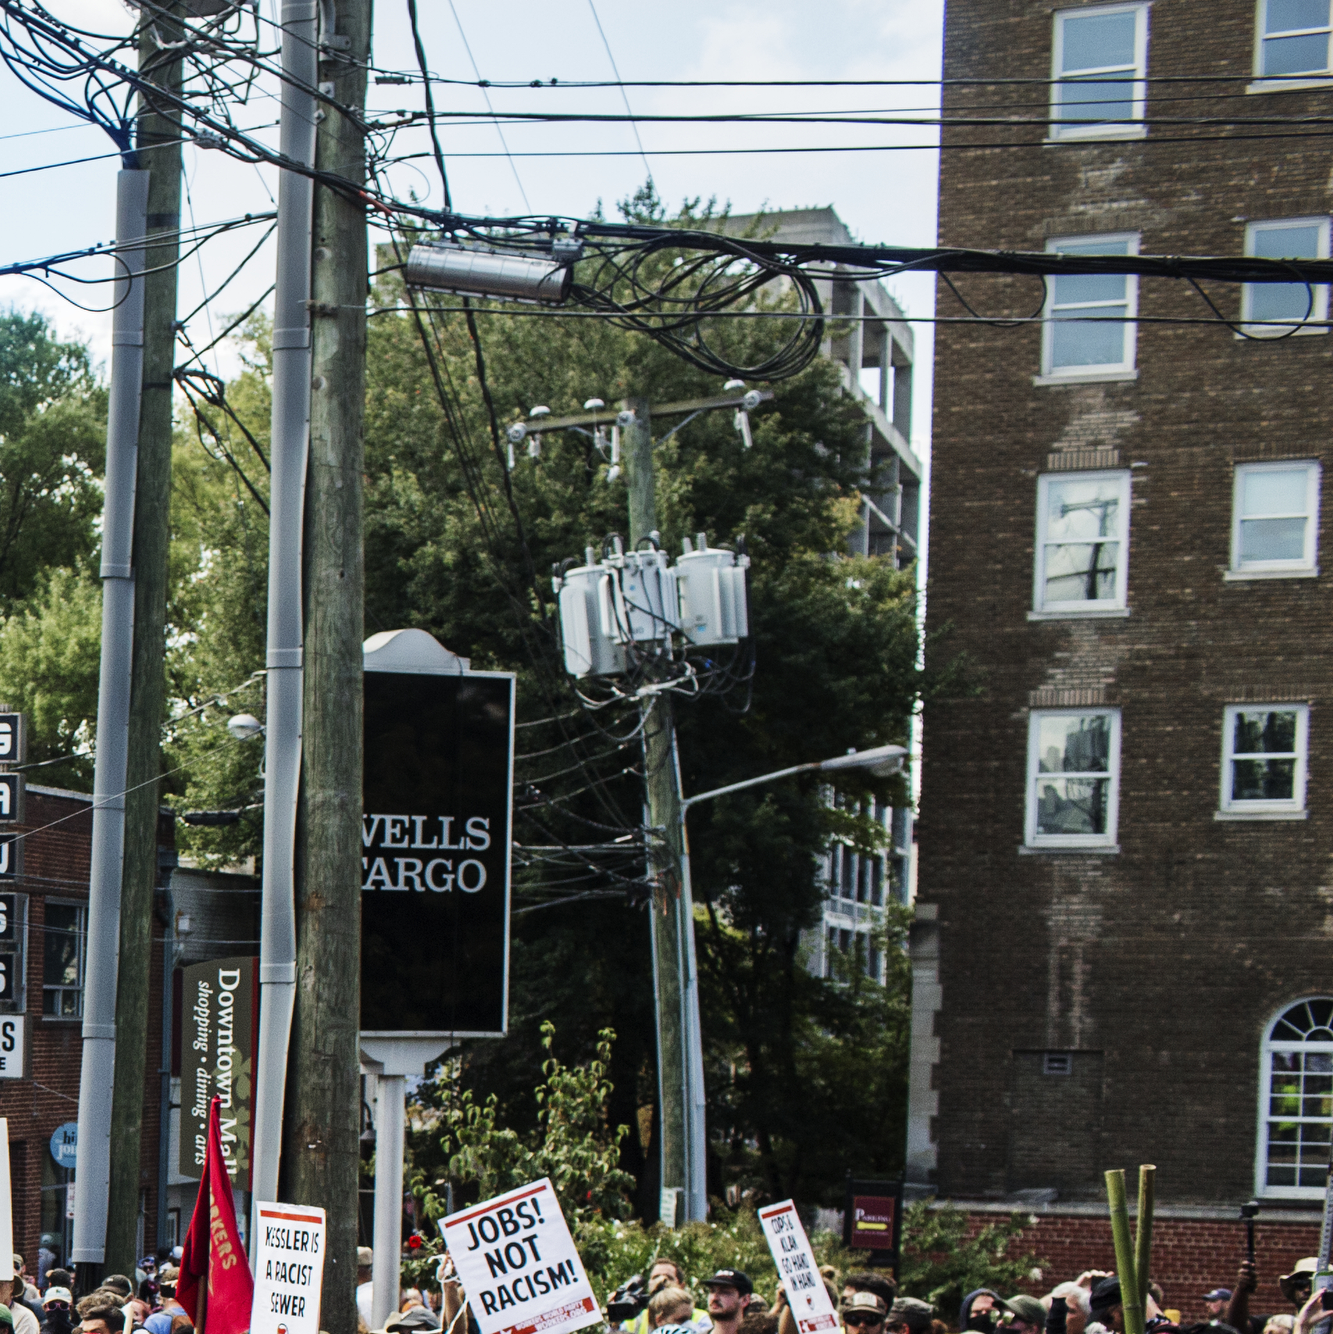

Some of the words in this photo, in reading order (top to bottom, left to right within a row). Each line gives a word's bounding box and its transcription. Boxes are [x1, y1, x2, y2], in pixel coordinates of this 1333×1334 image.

[362, 857, 487, 893] ARGO
[193, 980, 214, 1052] shopping
[216, 968, 241, 1109] Downtown
[192, 1068, 211, 1119] dining
[63, 1131, 77, 1145] hi
[265, 1226, 309, 1252] KESSLER
[311, 1232, 320, 1254] IS
[467, 1197, 545, 1251] JOBS!
[265, 1260, 273, 1280] A
[275, 1261, 313, 1286] RACIST
[484, 1233, 542, 1279] NOT
[781, 1257, 793, 1274] GO
[270, 1292, 306, 1318] SEWER
[479, 1259, 579, 1316] RACISM!
